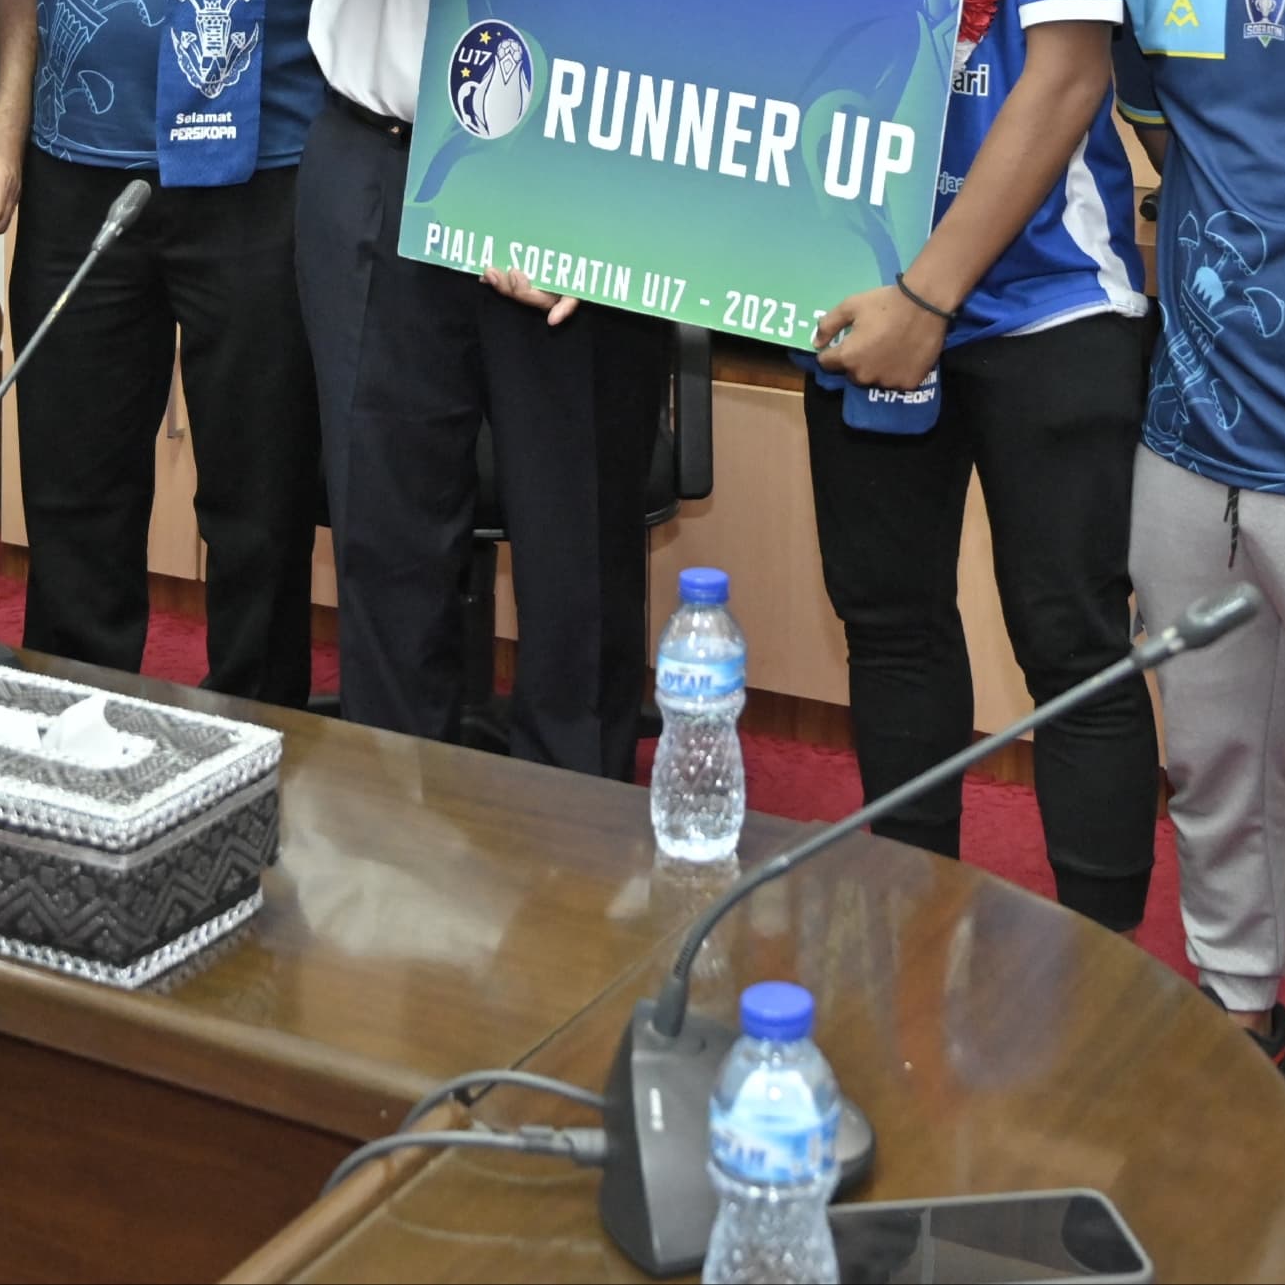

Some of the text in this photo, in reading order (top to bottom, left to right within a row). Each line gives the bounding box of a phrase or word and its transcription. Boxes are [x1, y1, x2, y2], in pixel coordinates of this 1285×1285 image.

[1246, 25, 1283, 36] SOERATIN
[459, 47, 492, 66] U17
[176, 111, 233, 124] Selamat
[170, 125, 237, 141] PERSIKOPA
[543, 58, 916, 206] RUNNER UP
[424, 222, 495, 268] PIALA
[507, 241, 631, 302] SOERATIN
[641, 271, 687, 314] U17
[868, 387, 935, 404] U-17-2024
